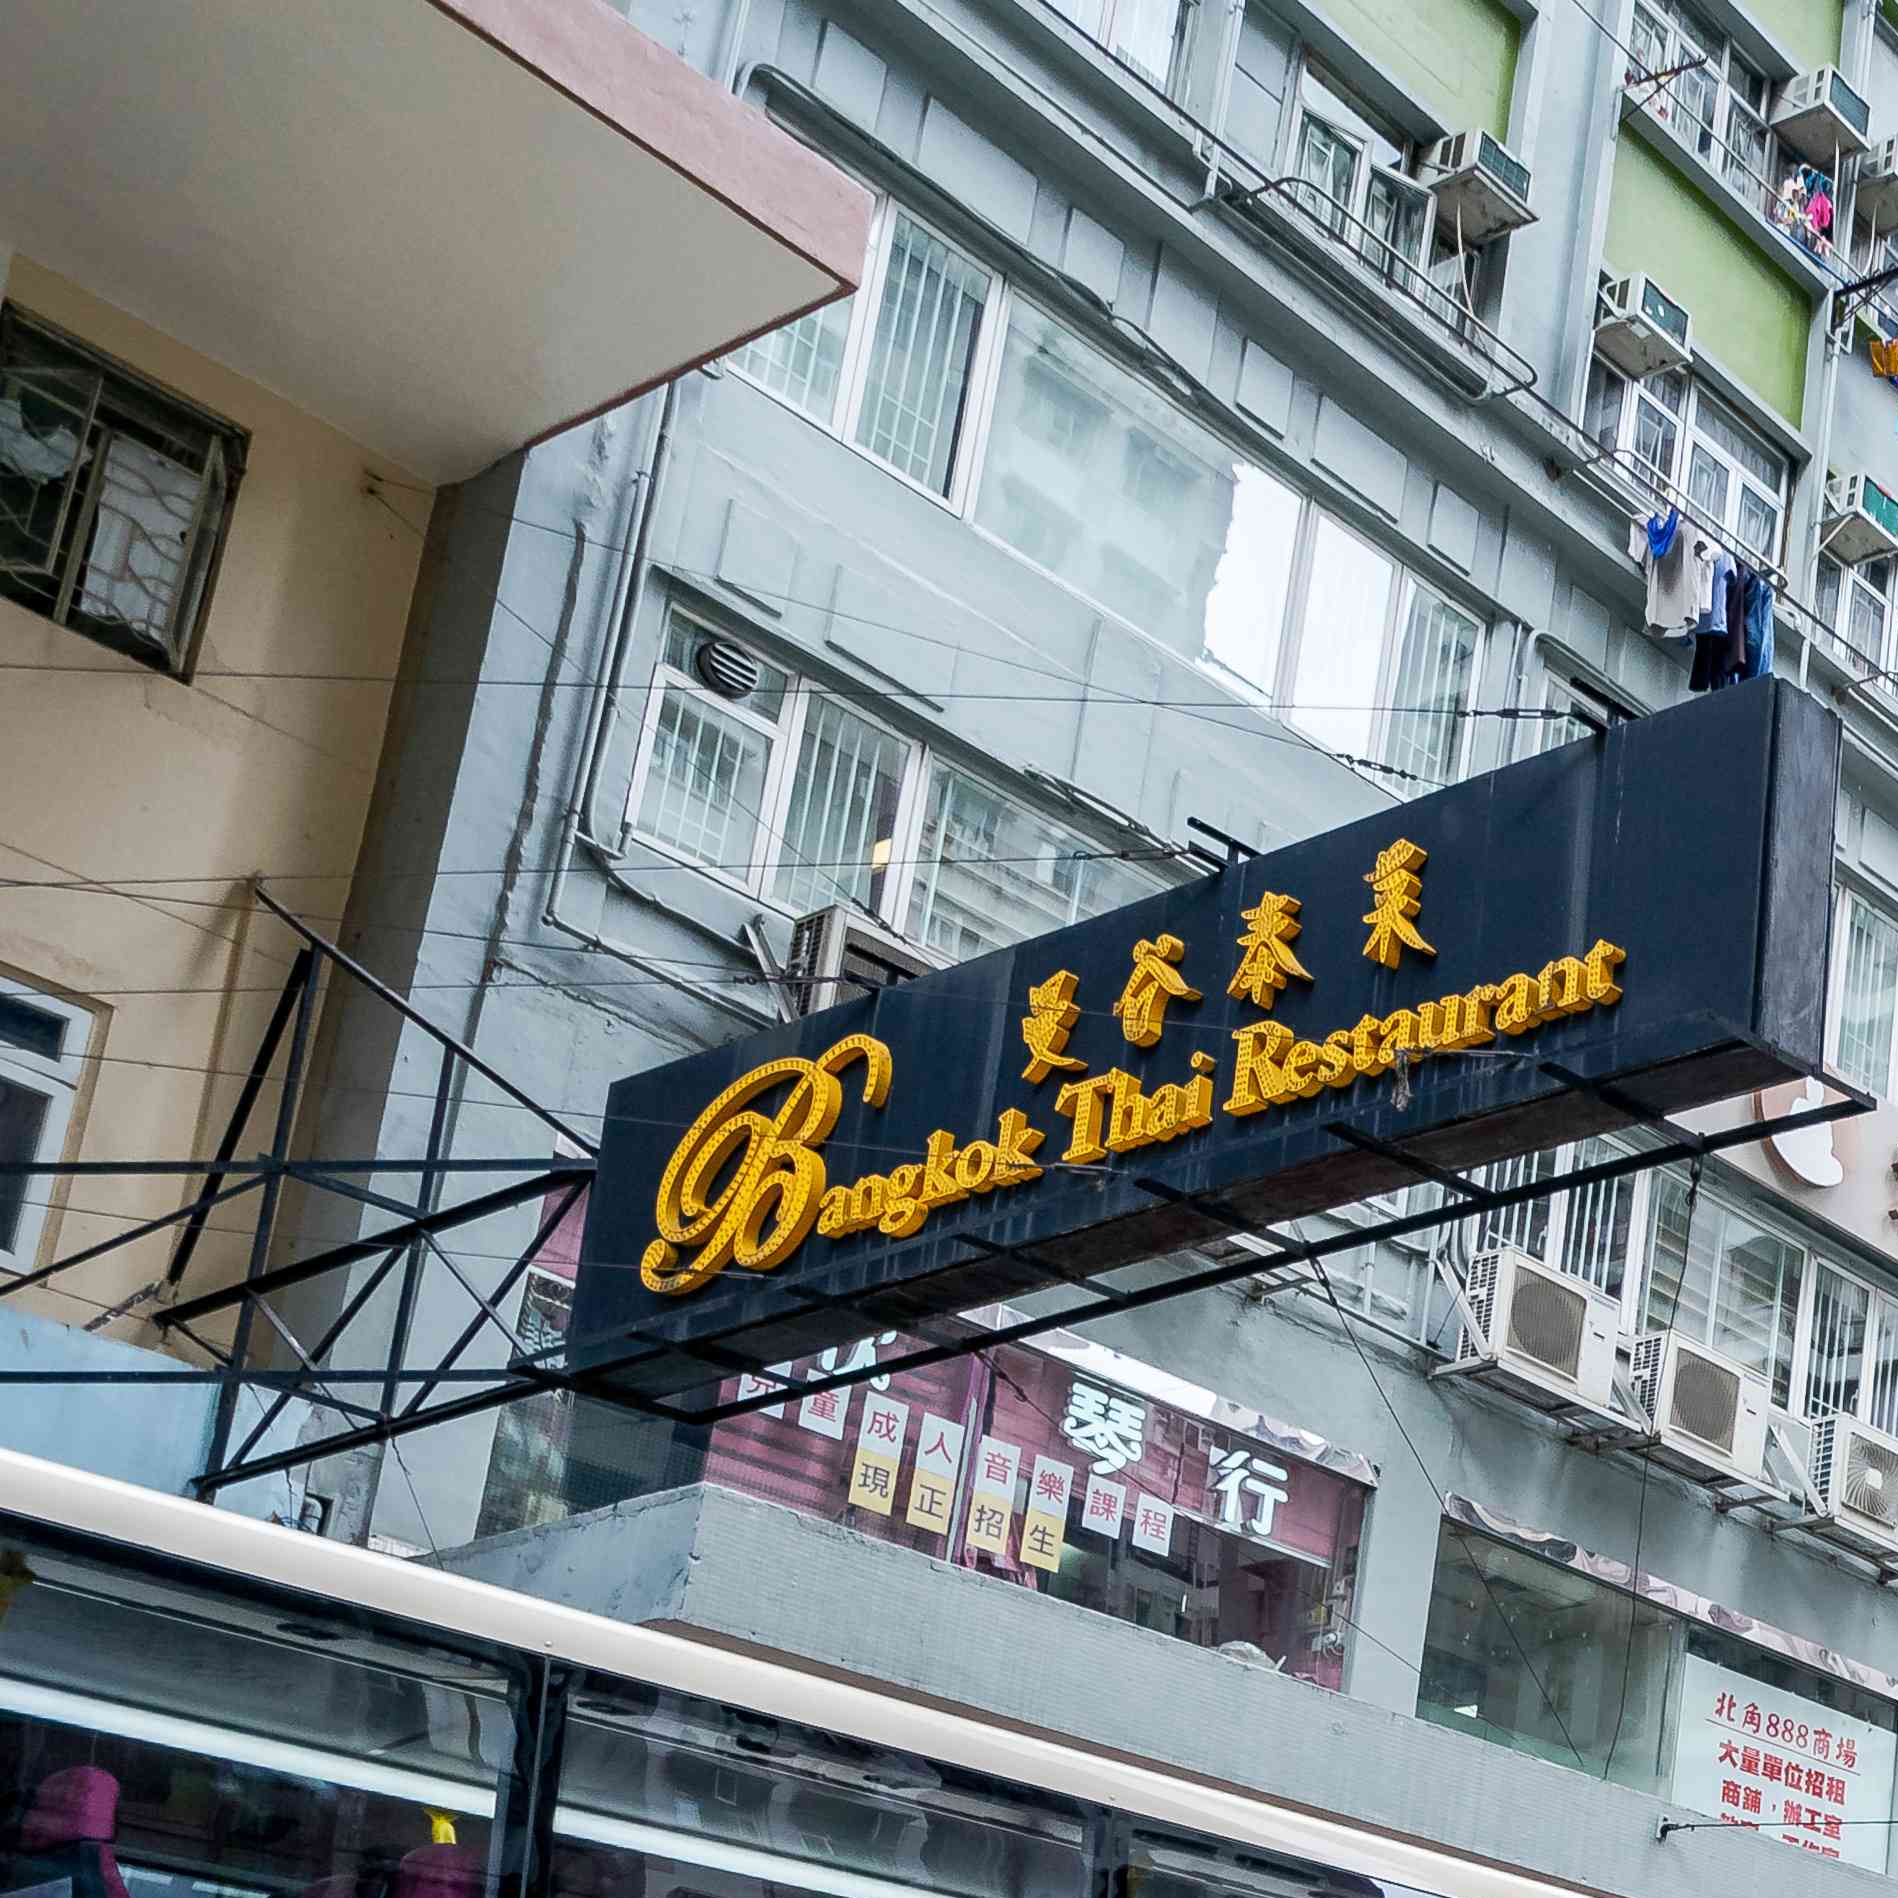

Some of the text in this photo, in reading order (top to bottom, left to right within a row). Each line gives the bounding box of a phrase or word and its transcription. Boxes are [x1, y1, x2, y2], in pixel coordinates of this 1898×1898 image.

[1020, 838, 1437, 1085] 曼谷泰菜
[640, 938, 1626, 1295] Bangkok Thai Restaurant
[859, 1462, 1056, 1557] 現正招生
[1715, 1691, 1858, 1769] 北角888商場
[1718, 1739, 1847, 1806] 大量單位招租
